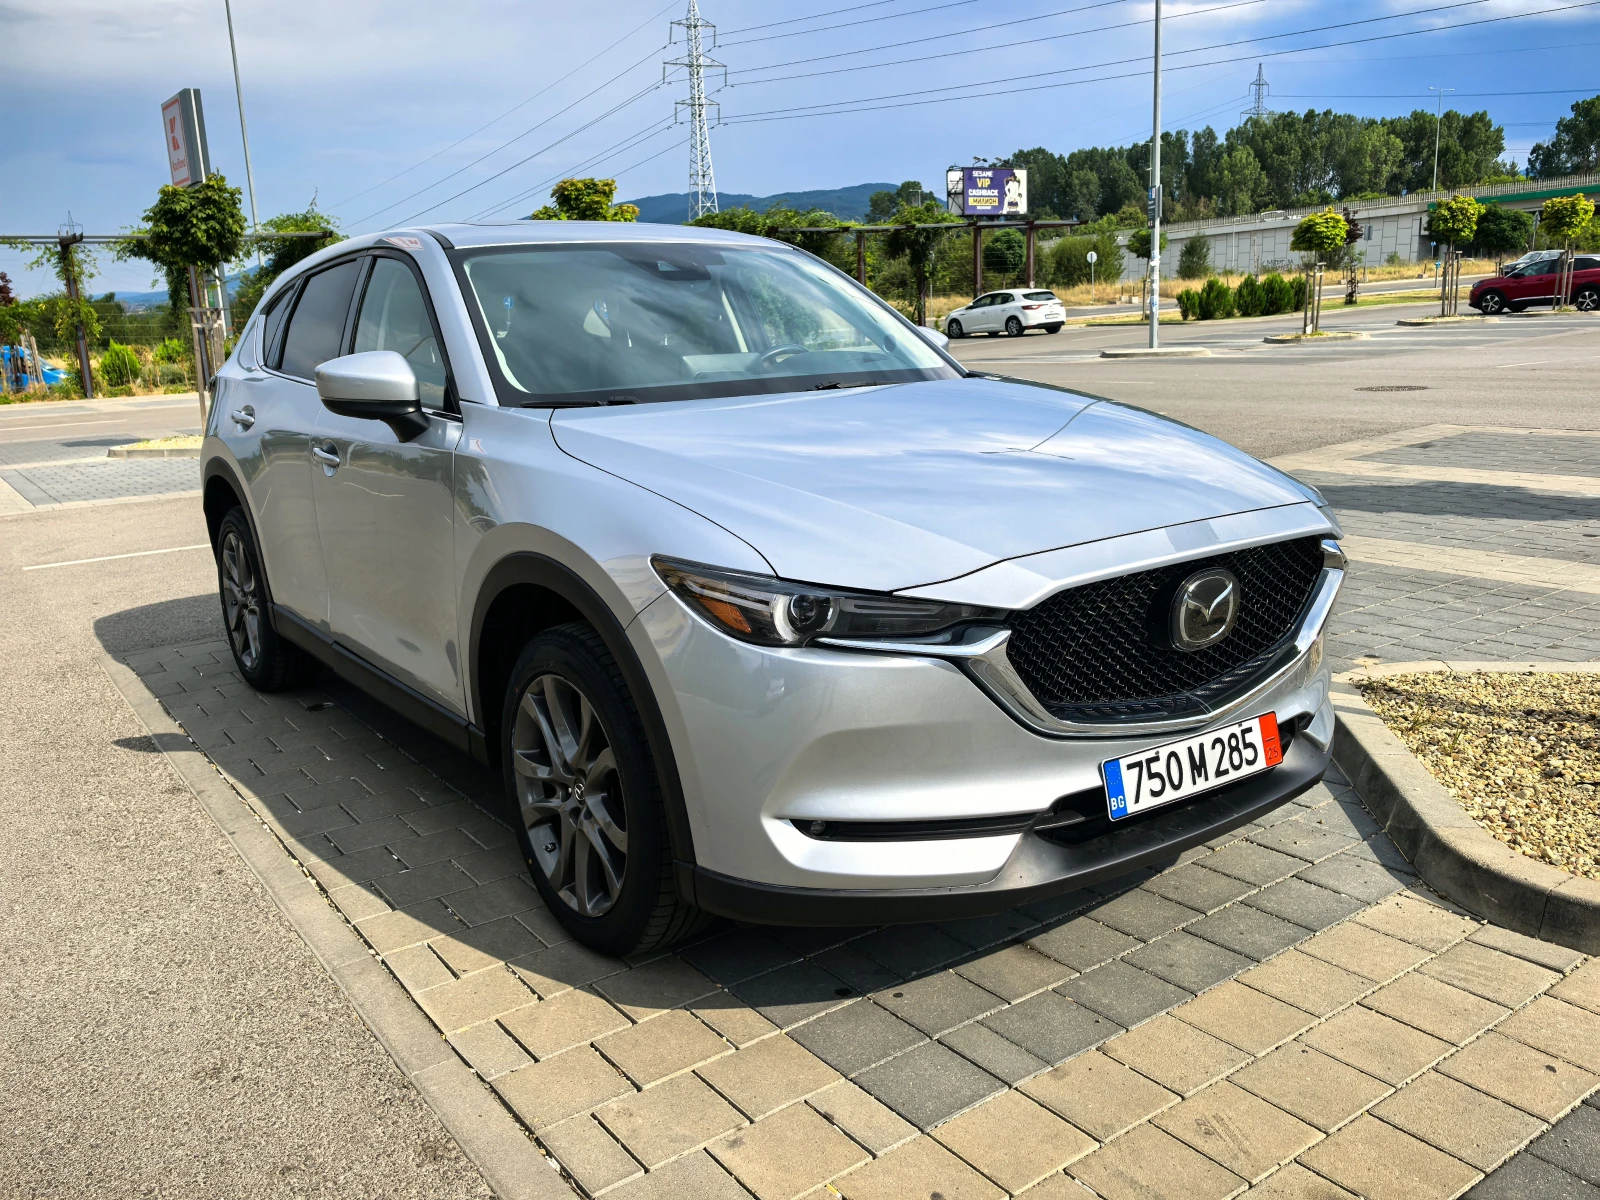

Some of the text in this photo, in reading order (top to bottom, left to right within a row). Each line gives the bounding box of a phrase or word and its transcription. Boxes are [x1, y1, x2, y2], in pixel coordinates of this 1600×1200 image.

[977, 178, 991, 187] VIP
[1126, 726, 1259, 805] 750 M 285
[1110, 795, 1125, 811] BG
